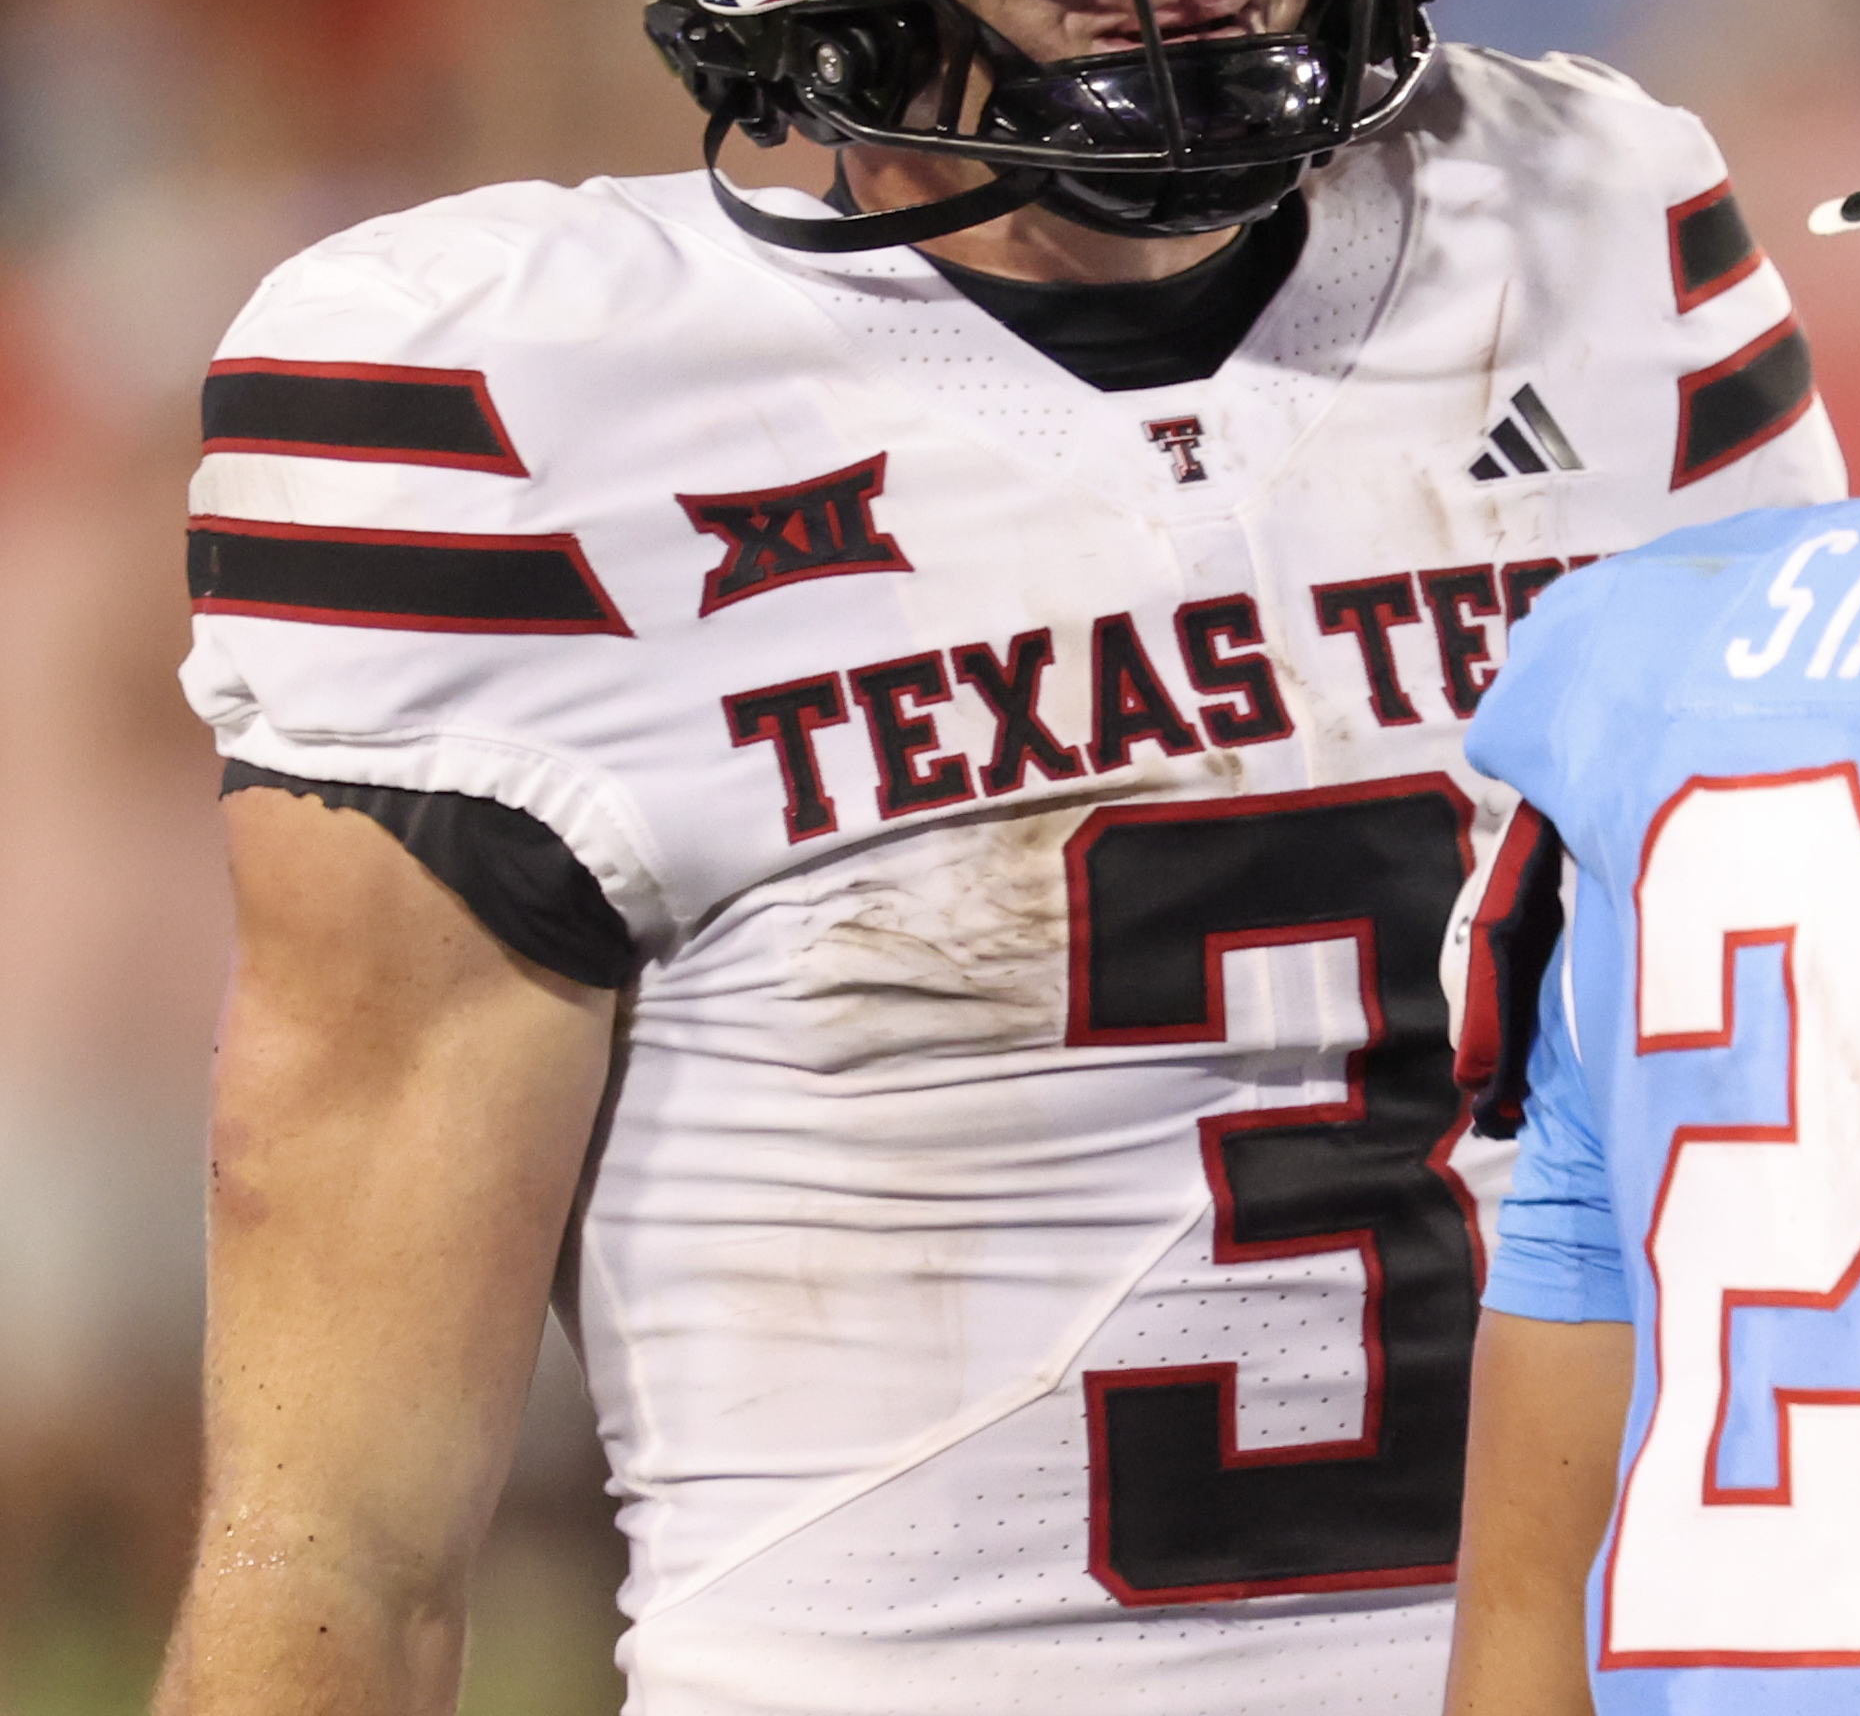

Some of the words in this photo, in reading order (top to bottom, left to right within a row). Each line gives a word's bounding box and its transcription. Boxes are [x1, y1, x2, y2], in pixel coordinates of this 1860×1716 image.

[721, 591, 1295, 845] TEXAS
[1312, 551, 1622, 727] TE
[1064, 770, 1488, 1606] 3
